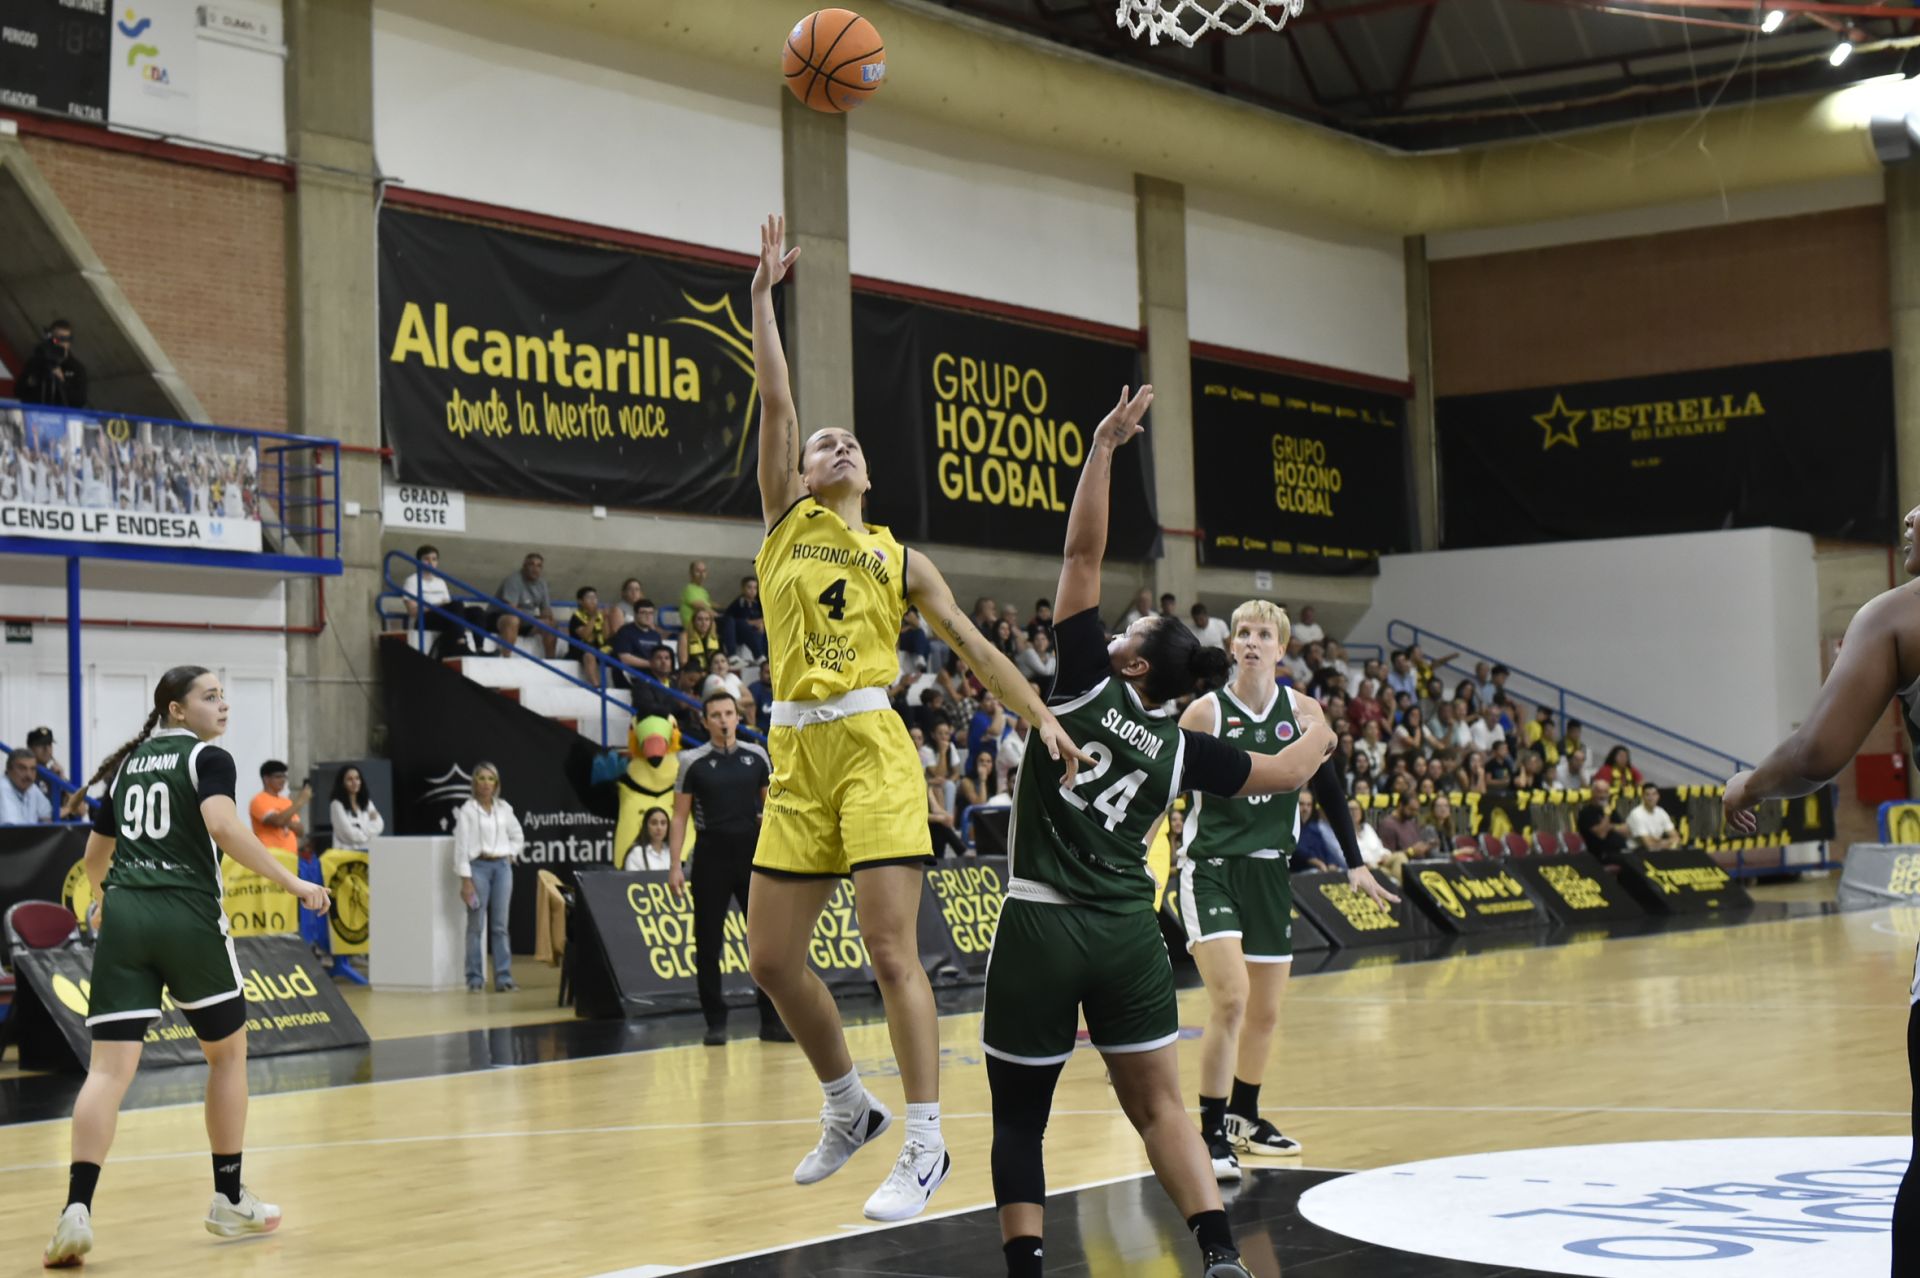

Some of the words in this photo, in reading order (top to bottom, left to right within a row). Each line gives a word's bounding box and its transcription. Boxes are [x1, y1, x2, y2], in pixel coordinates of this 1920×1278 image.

[68, 102, 103, 121] FALTAS
[391, 301, 700, 402] Alcantarilla
[932, 351, 1048, 416] GRUPO
[447, 387, 513, 438] donde
[516, 388, 541, 436] la
[543, 391, 614, 442] huerta
[618, 402, 670, 438] nace
[1590, 391, 1766, 432] ESTRELLA
[935, 401, 1084, 468] HOZONO
[1655, 419, 1727, 439] LEVANTE
[1272, 433, 1326, 466] GRUPO
[937, 452, 1067, 513] GLOBAL
[1273, 460, 1343, 493] HOZONO
[399, 486, 450, 507] GRADA
[1275, 485, 1335, 517] GLOBAL
[1, 506, 75, 533] CENSO
[81, 510, 109, 533] LF
[116, 514, 201, 540] ENDESA
[403, 506, 447, 525] OESTE
[791, 543, 850, 566] HOZONO
[818, 577, 848, 621] 4
[1100, 706, 1165, 760] SLOCUM
[1058, 740, 1150, 833] 24
[120, 781, 172, 841] 90
[926, 865, 1002, 899] GRUPO
[273, 1011, 331, 1032] persona
